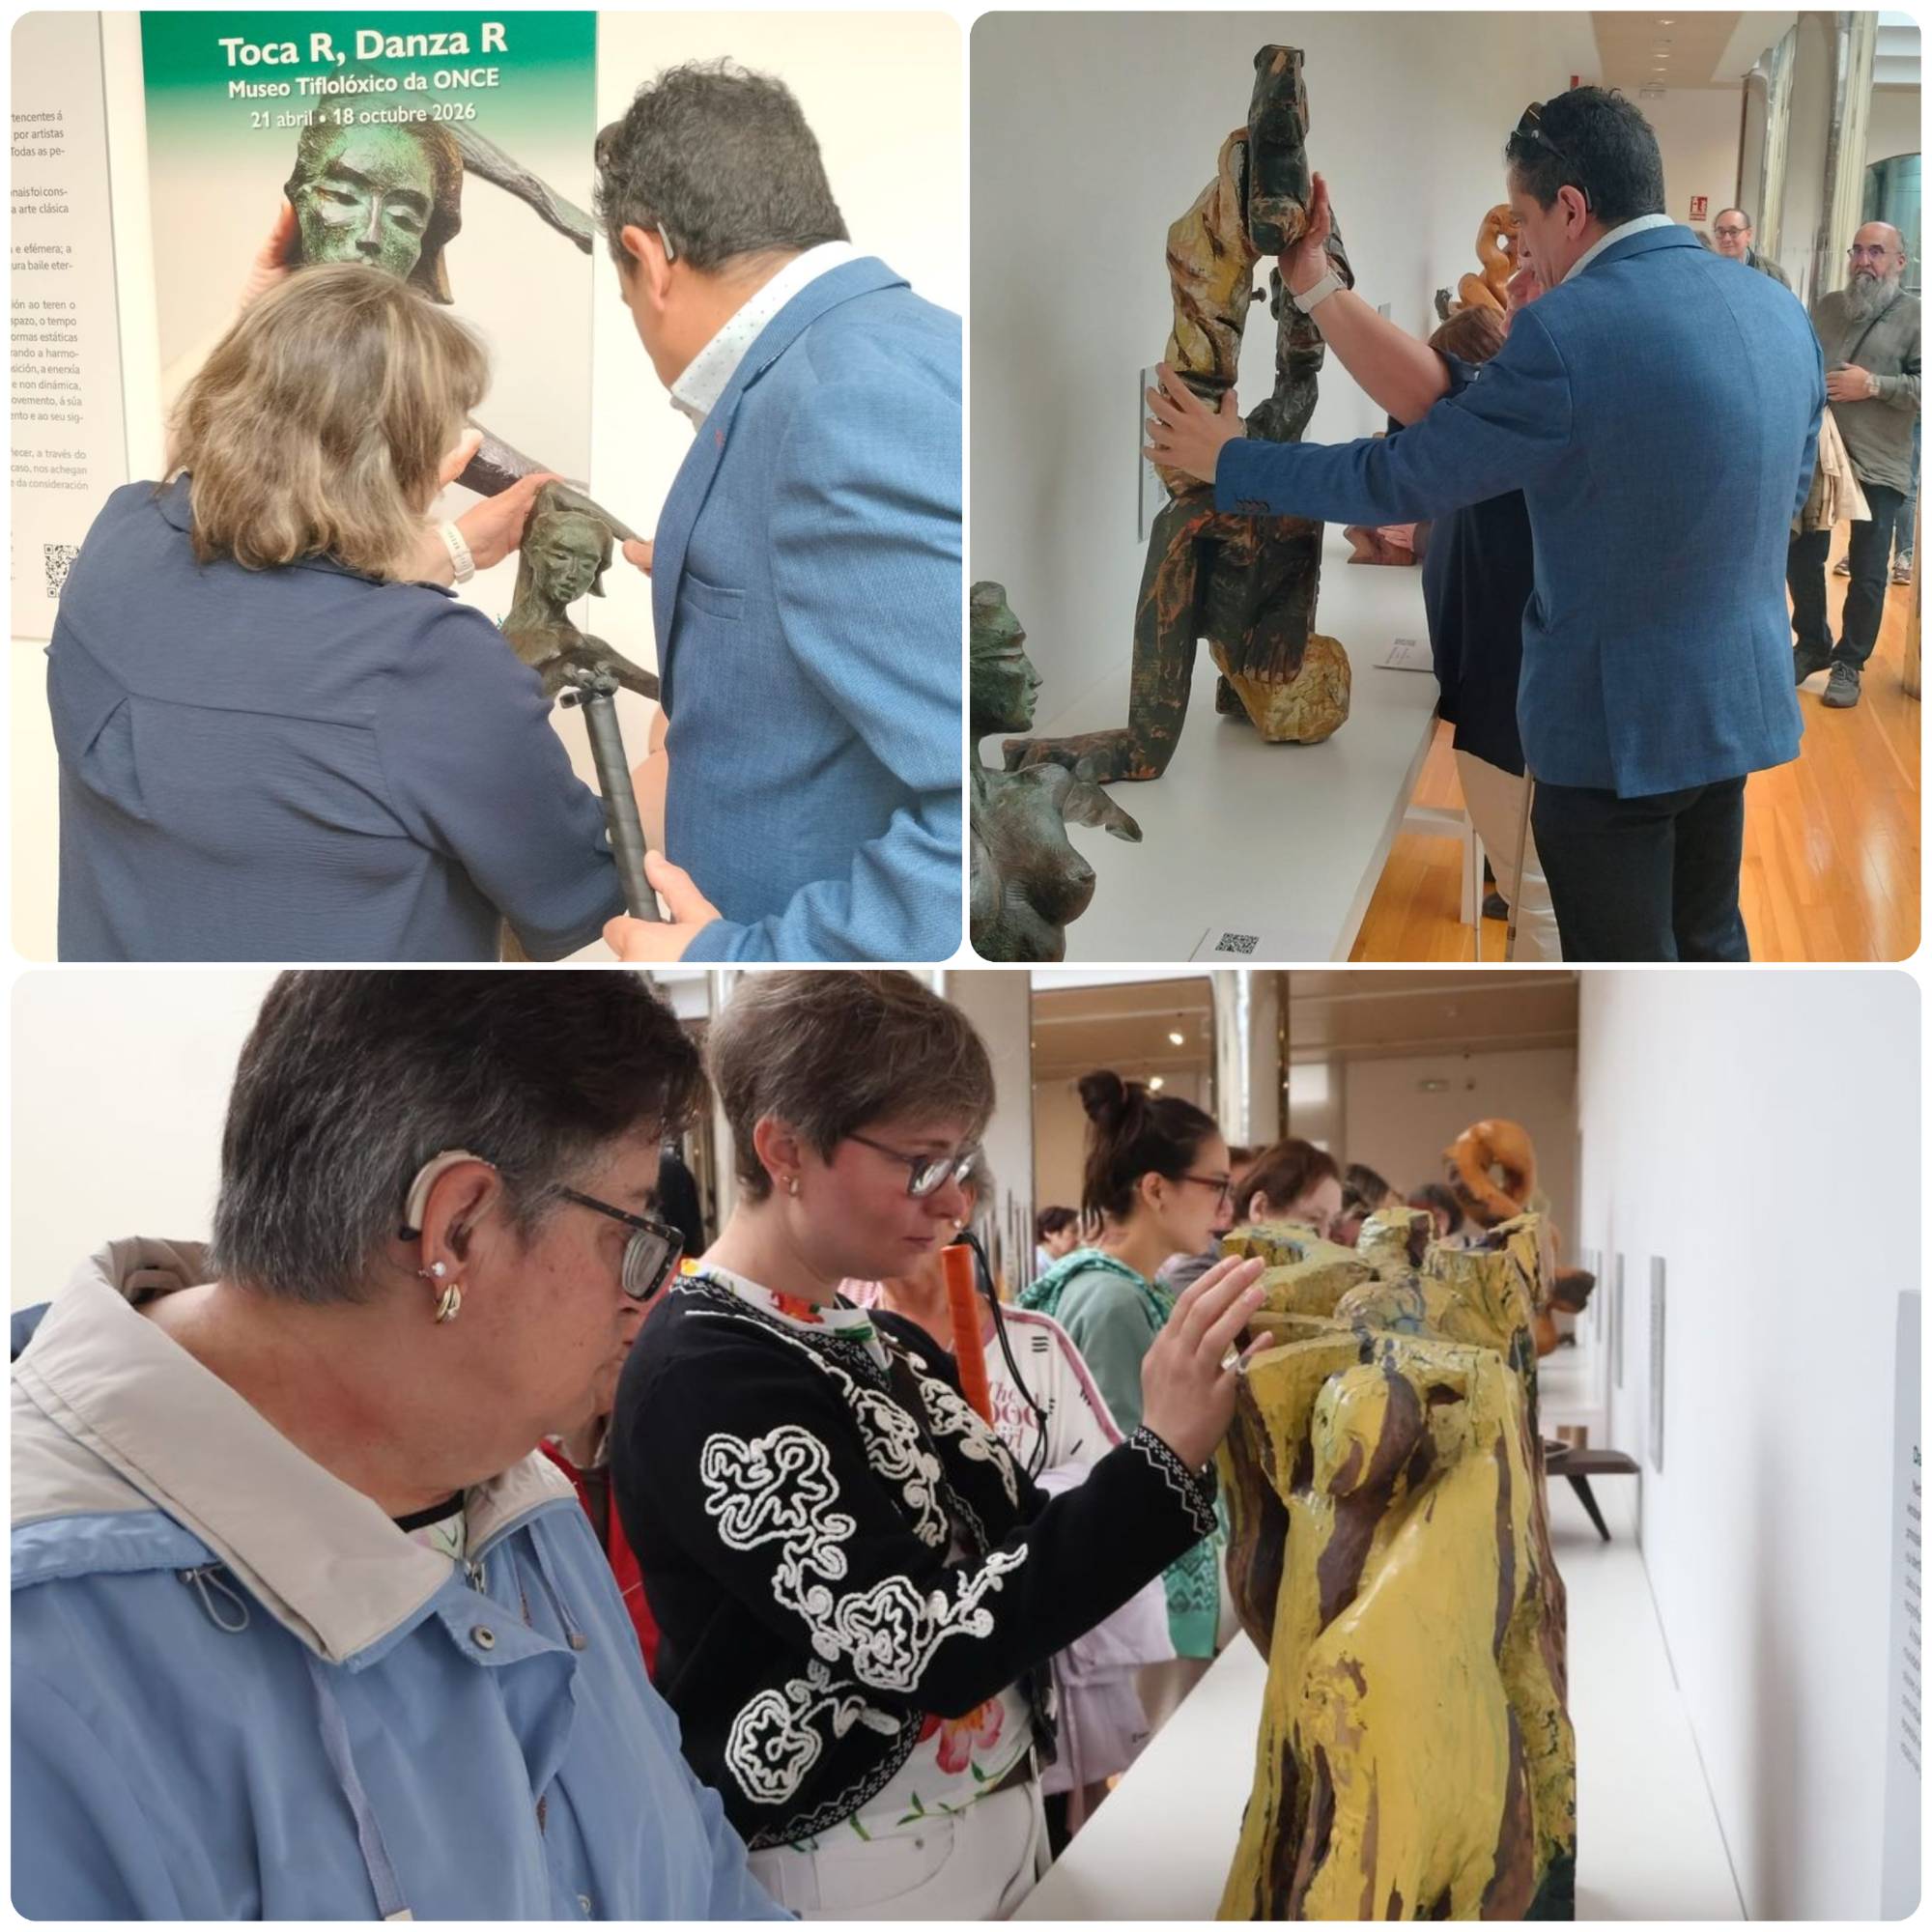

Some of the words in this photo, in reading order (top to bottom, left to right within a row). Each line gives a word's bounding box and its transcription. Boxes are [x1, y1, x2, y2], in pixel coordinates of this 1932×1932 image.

[218, 37, 300, 67] Toca
[309, 32, 347, 67] R,
[355, 29, 470, 60] Danza
[481, 21, 508, 52] R
[228, 80, 291, 99] Museo
[295, 74, 398, 96] Tiflolóxico
[403, 71, 428, 90] da
[433, 68, 499, 89] ONCE
[250, 110, 271, 128] 21
[277, 110, 313, 127] abril
[332, 107, 355, 125] 18
[359, 105, 427, 124] octubre
[432, 102, 476, 121] 2026
[14, 130, 29, 142] por
[31, 128, 64, 139] artistas
[38, 148, 47, 156] as
[49, 148, 65, 158] pe-
[18, 204, 37, 214] arte
[39, 203, 70, 214] clásica
[65, 245, 71, 254] a
[27, 259, 50, 270] baile
[51, 260, 73, 270] eter-
[28, 301, 41, 310] ao
[43, 300, 67, 310] teren
[69, 301, 76, 310] o
[47, 317, 77, 328] tempo
[40, 331, 78, 342] estáticas
[45, 348, 79, 358] harmo-
[47, 364, 80, 375] enerxía
[19, 381, 37, 389] non
[38, 380, 81, 391] dinámica,
[37, 412, 48, 421] ao
[44, 449, 72, 460] través
[73, 448, 87, 460] do
[34, 465, 48, 473] nos
[50, 465, 88, 477] achegan
[16, 478, 27, 488] da
[29, 479, 89, 491] consideración
